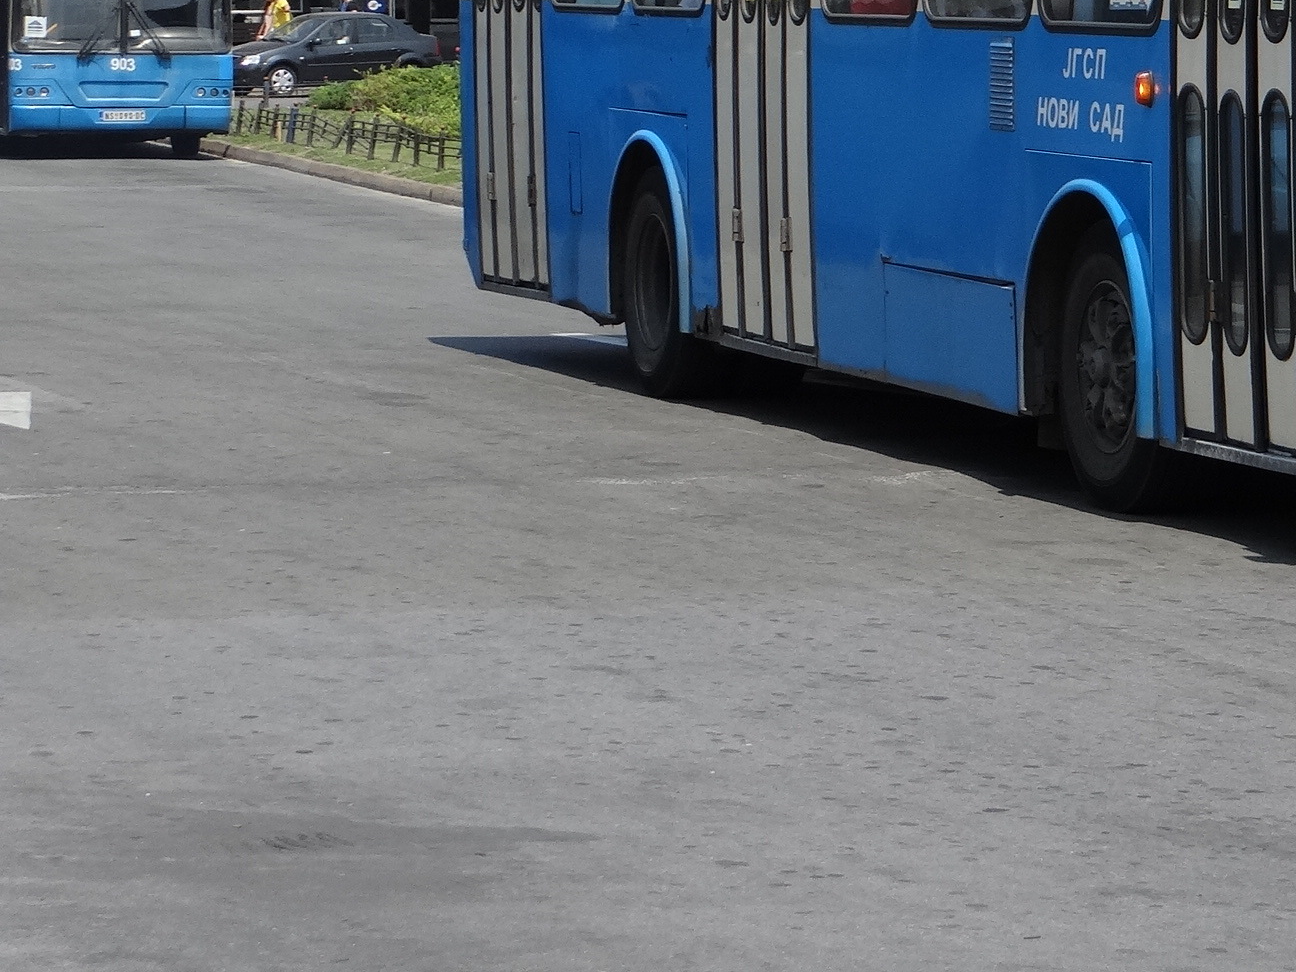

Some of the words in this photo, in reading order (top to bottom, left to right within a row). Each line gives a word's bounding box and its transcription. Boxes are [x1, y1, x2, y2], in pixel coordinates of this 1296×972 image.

[110, 57, 137, 71] 903
[1037, 96, 1079, 130] НОВИ
[1089, 101, 1125, 143] САД
